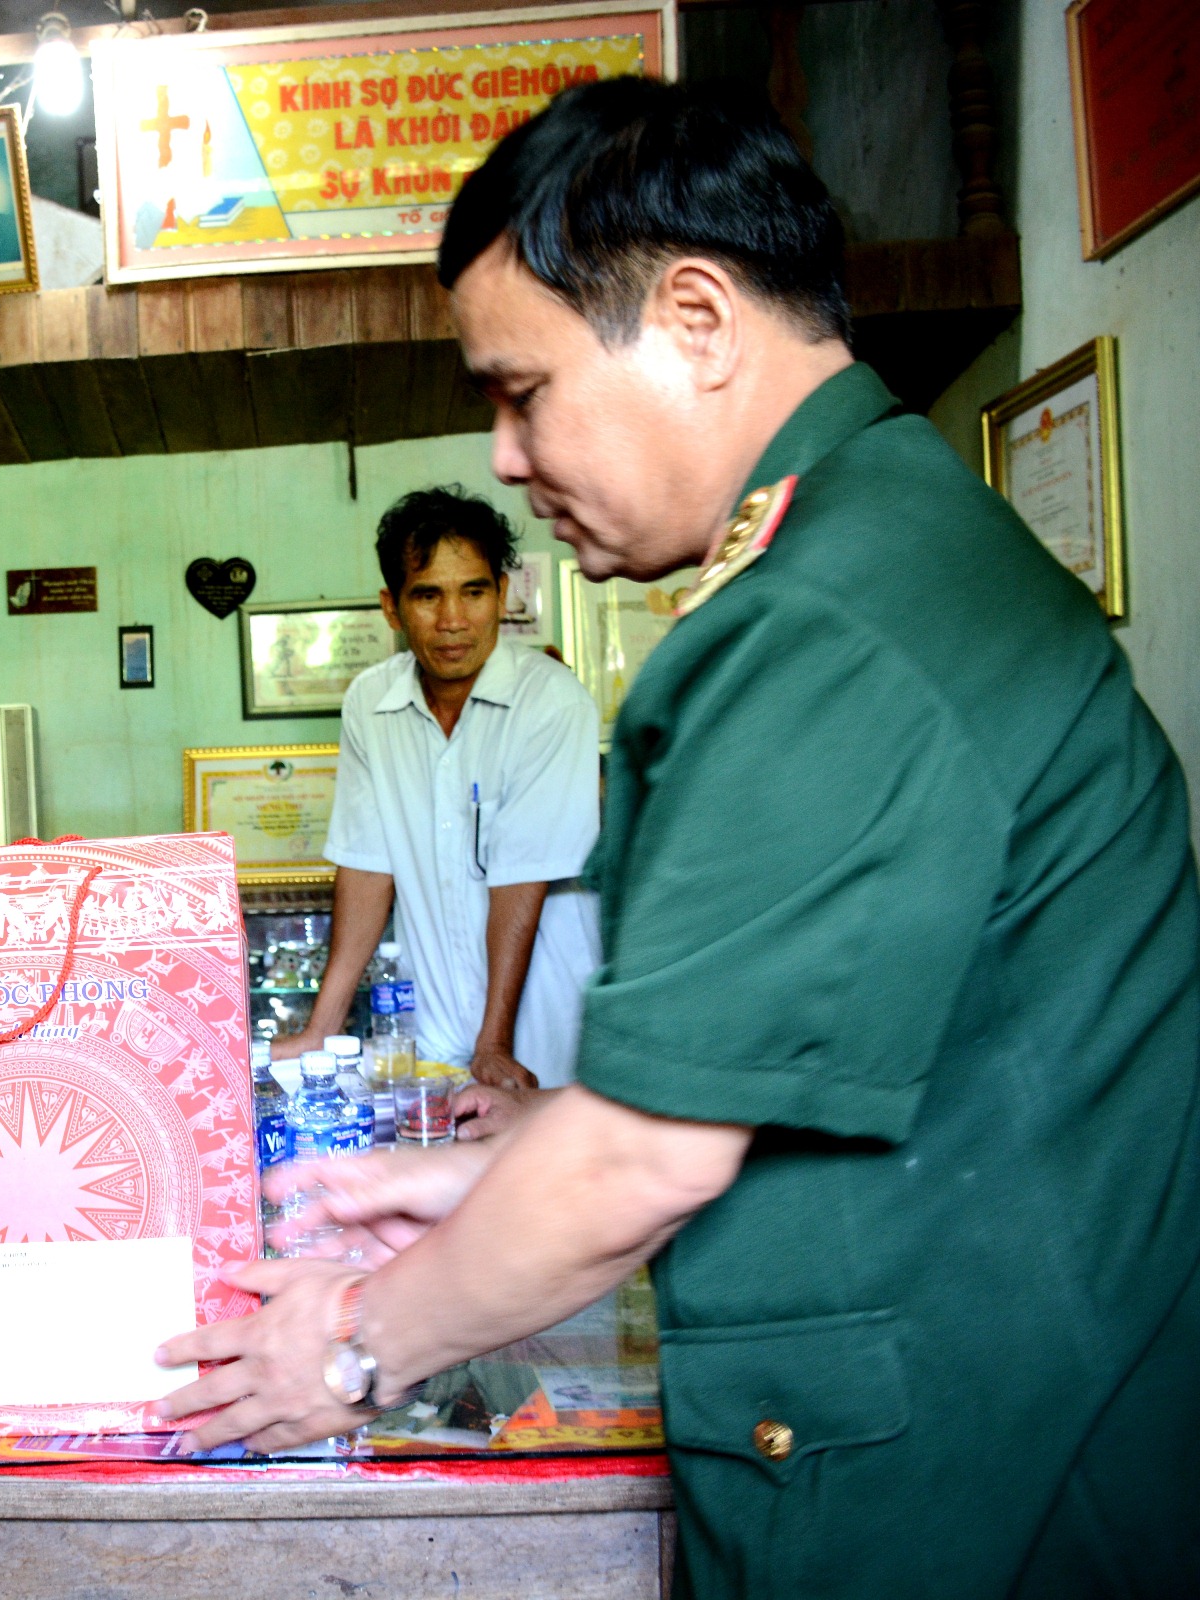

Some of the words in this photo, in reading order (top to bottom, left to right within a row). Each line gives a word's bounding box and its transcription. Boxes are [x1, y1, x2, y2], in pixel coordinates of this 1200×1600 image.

[279, 76, 351, 113] KÍNH
[360, 75, 398, 110] SỢ
[406, 67, 464, 104] ĐỨC
[41, 974, 149, 1004] PHÒNG
